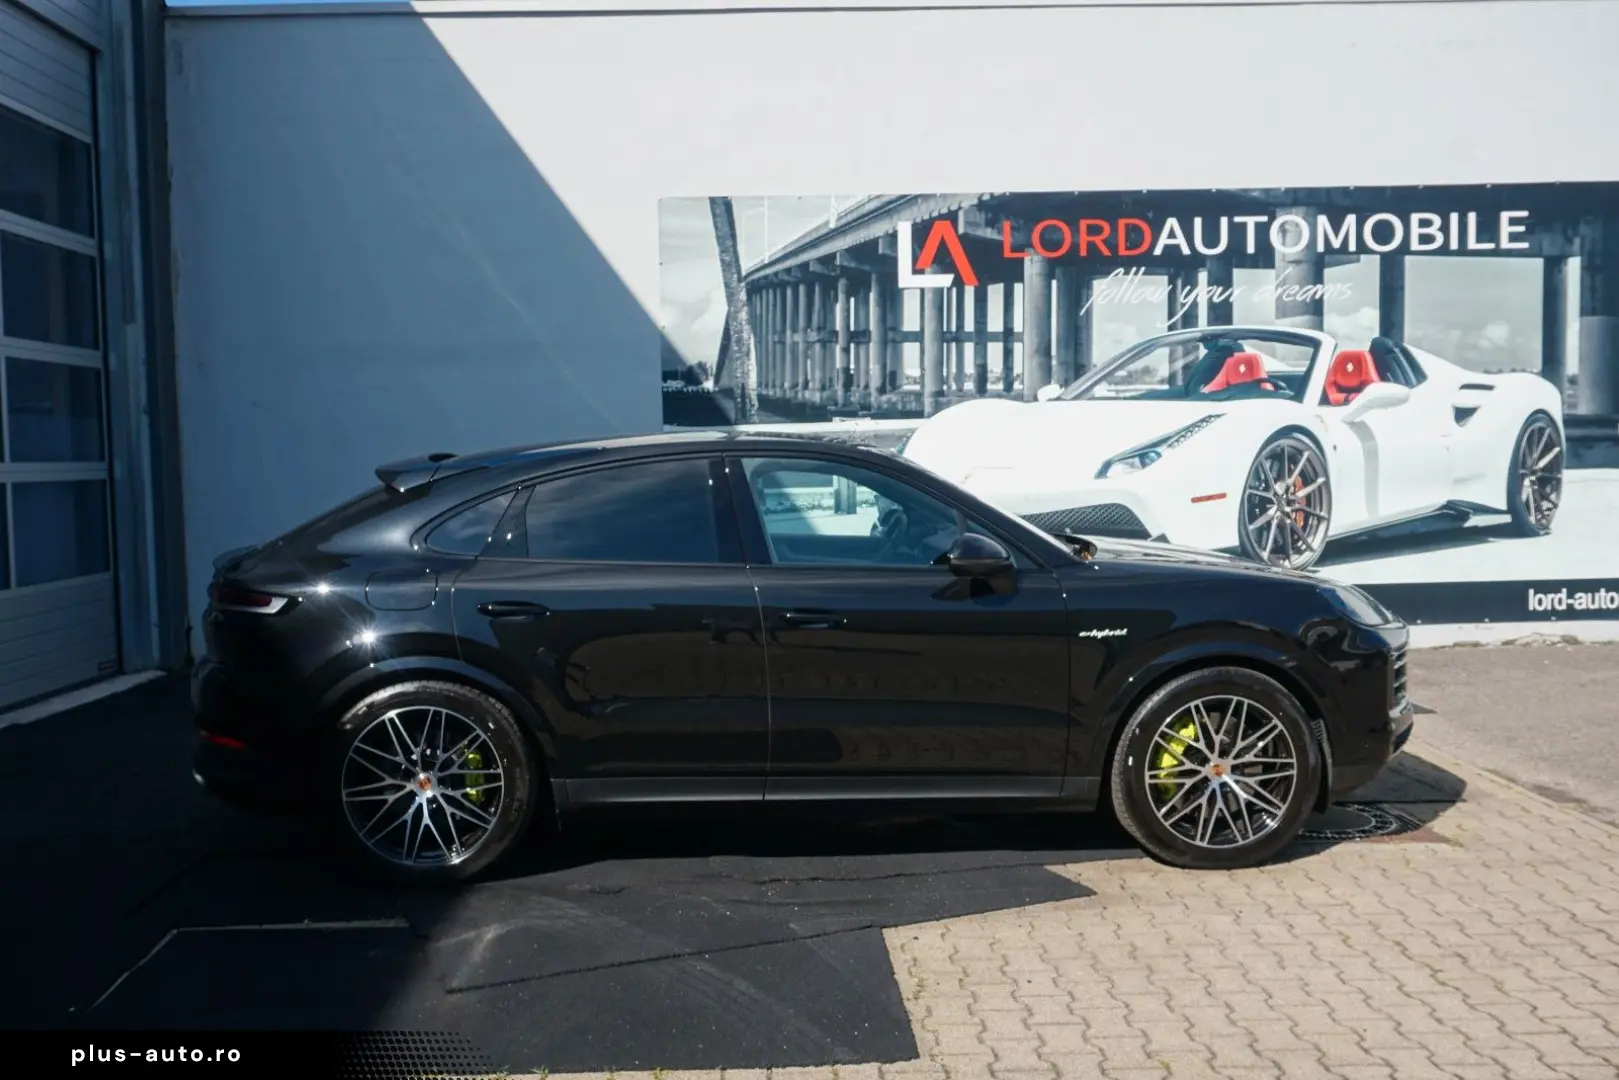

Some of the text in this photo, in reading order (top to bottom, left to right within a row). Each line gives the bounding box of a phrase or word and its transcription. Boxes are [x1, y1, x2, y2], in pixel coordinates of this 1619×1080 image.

[1003, 210, 1530, 258] LORDAUTOMOBILE
[1080, 267, 1353, 328] follow your dreams
[1528, 587, 1619, 611] lord-auto
